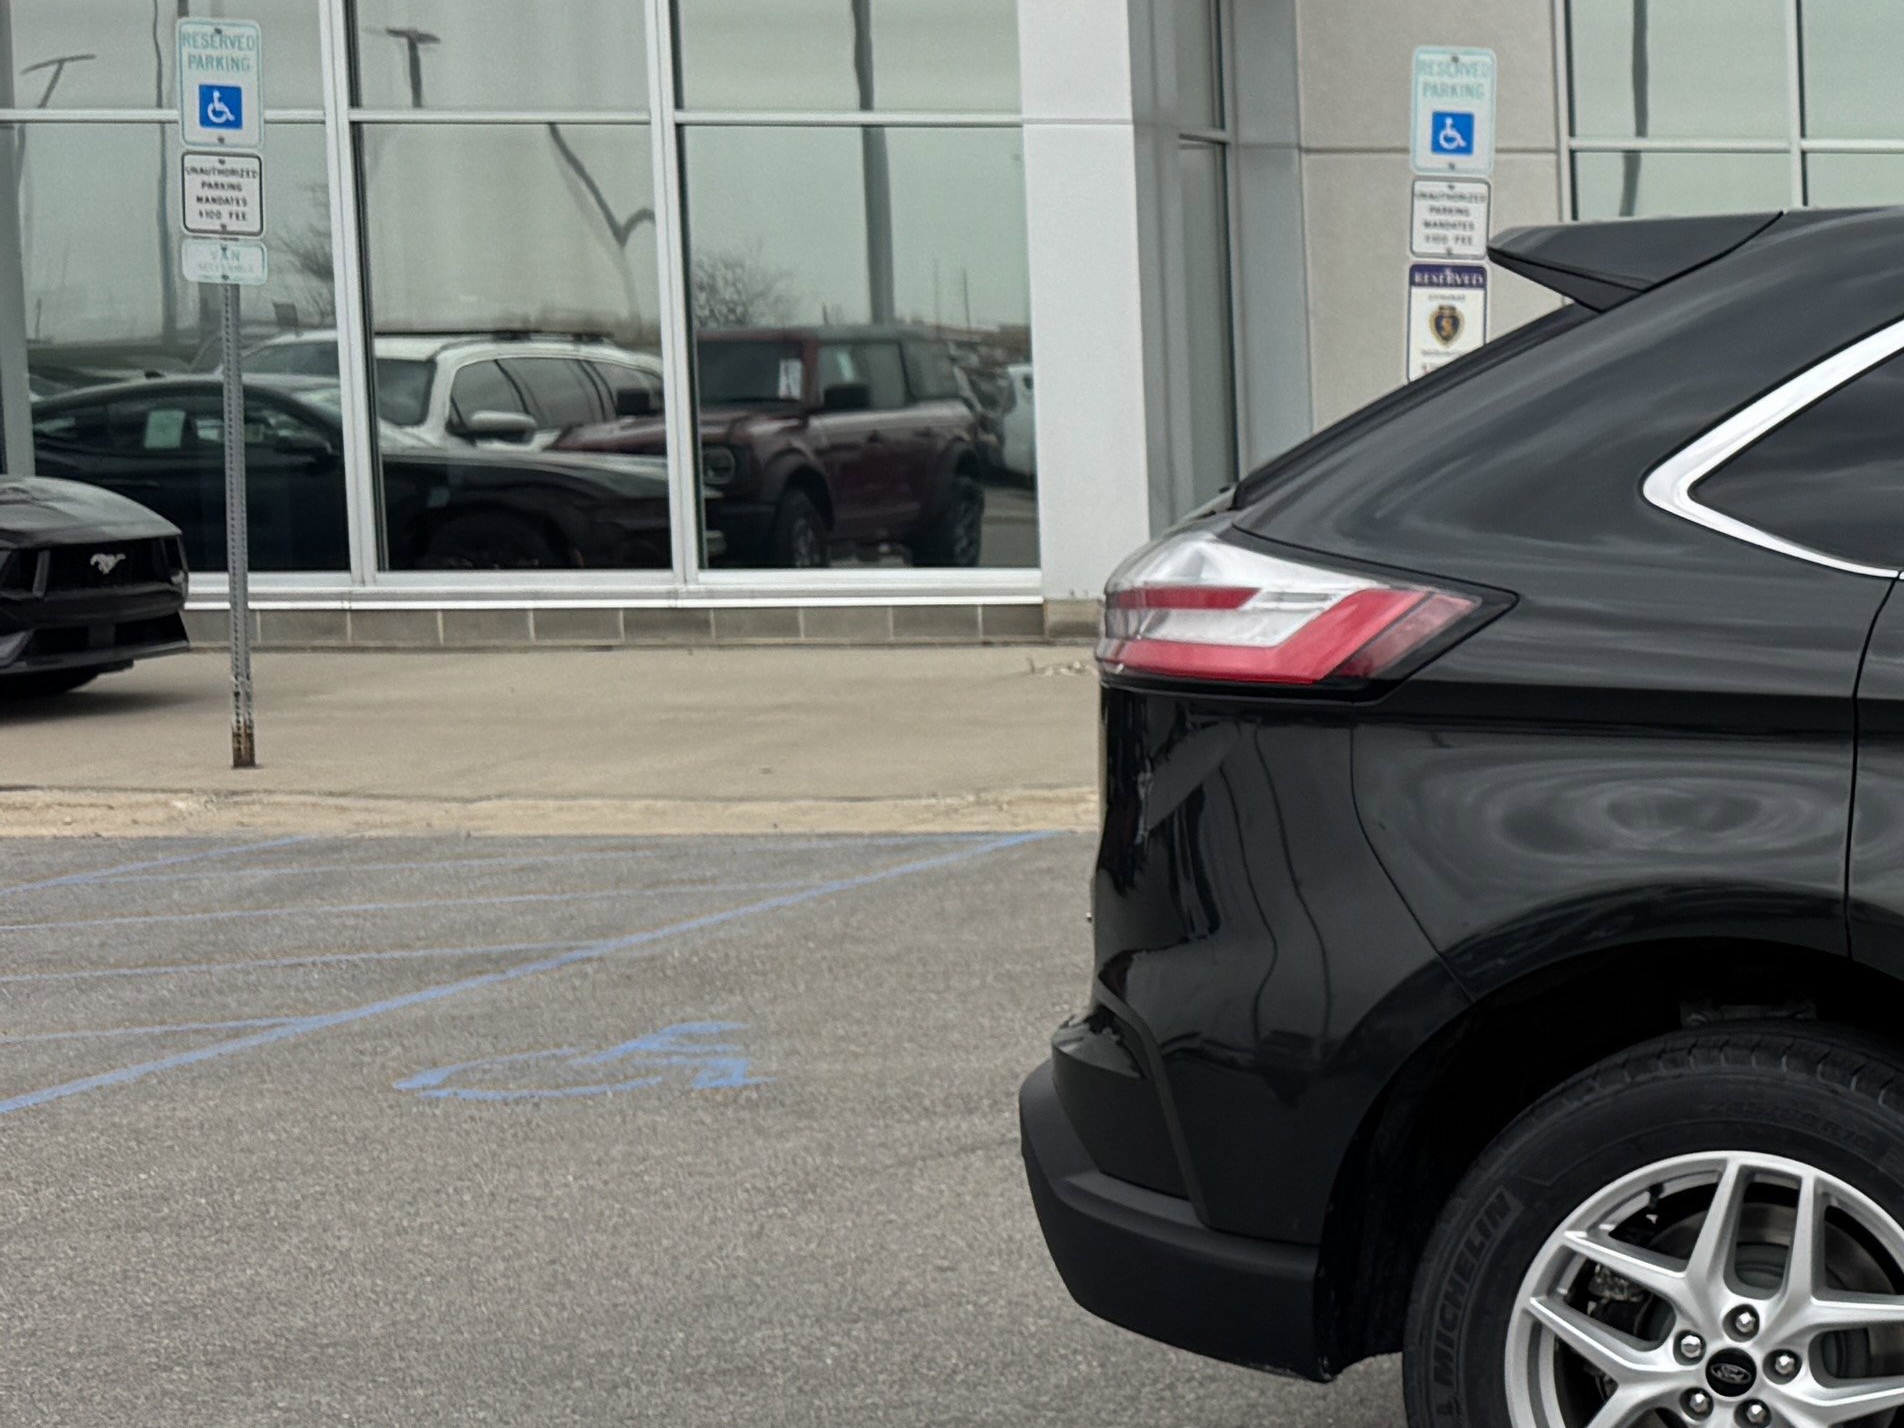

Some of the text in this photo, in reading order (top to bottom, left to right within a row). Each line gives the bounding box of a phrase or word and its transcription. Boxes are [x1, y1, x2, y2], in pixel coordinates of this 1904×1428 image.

[182, 32, 255, 53] RESERVED
[188, 55, 250, 73] PARKING
[1417, 61, 1488, 78] RESERVED
[1422, 81, 1484, 100] PARKING
[186, 166, 257, 179] UNAUTHORIZED
[201, 181, 243, 193] PARKING
[196, 195, 248, 207] MANDATES
[1433, 1190, 1514, 1388] MICHELIN
